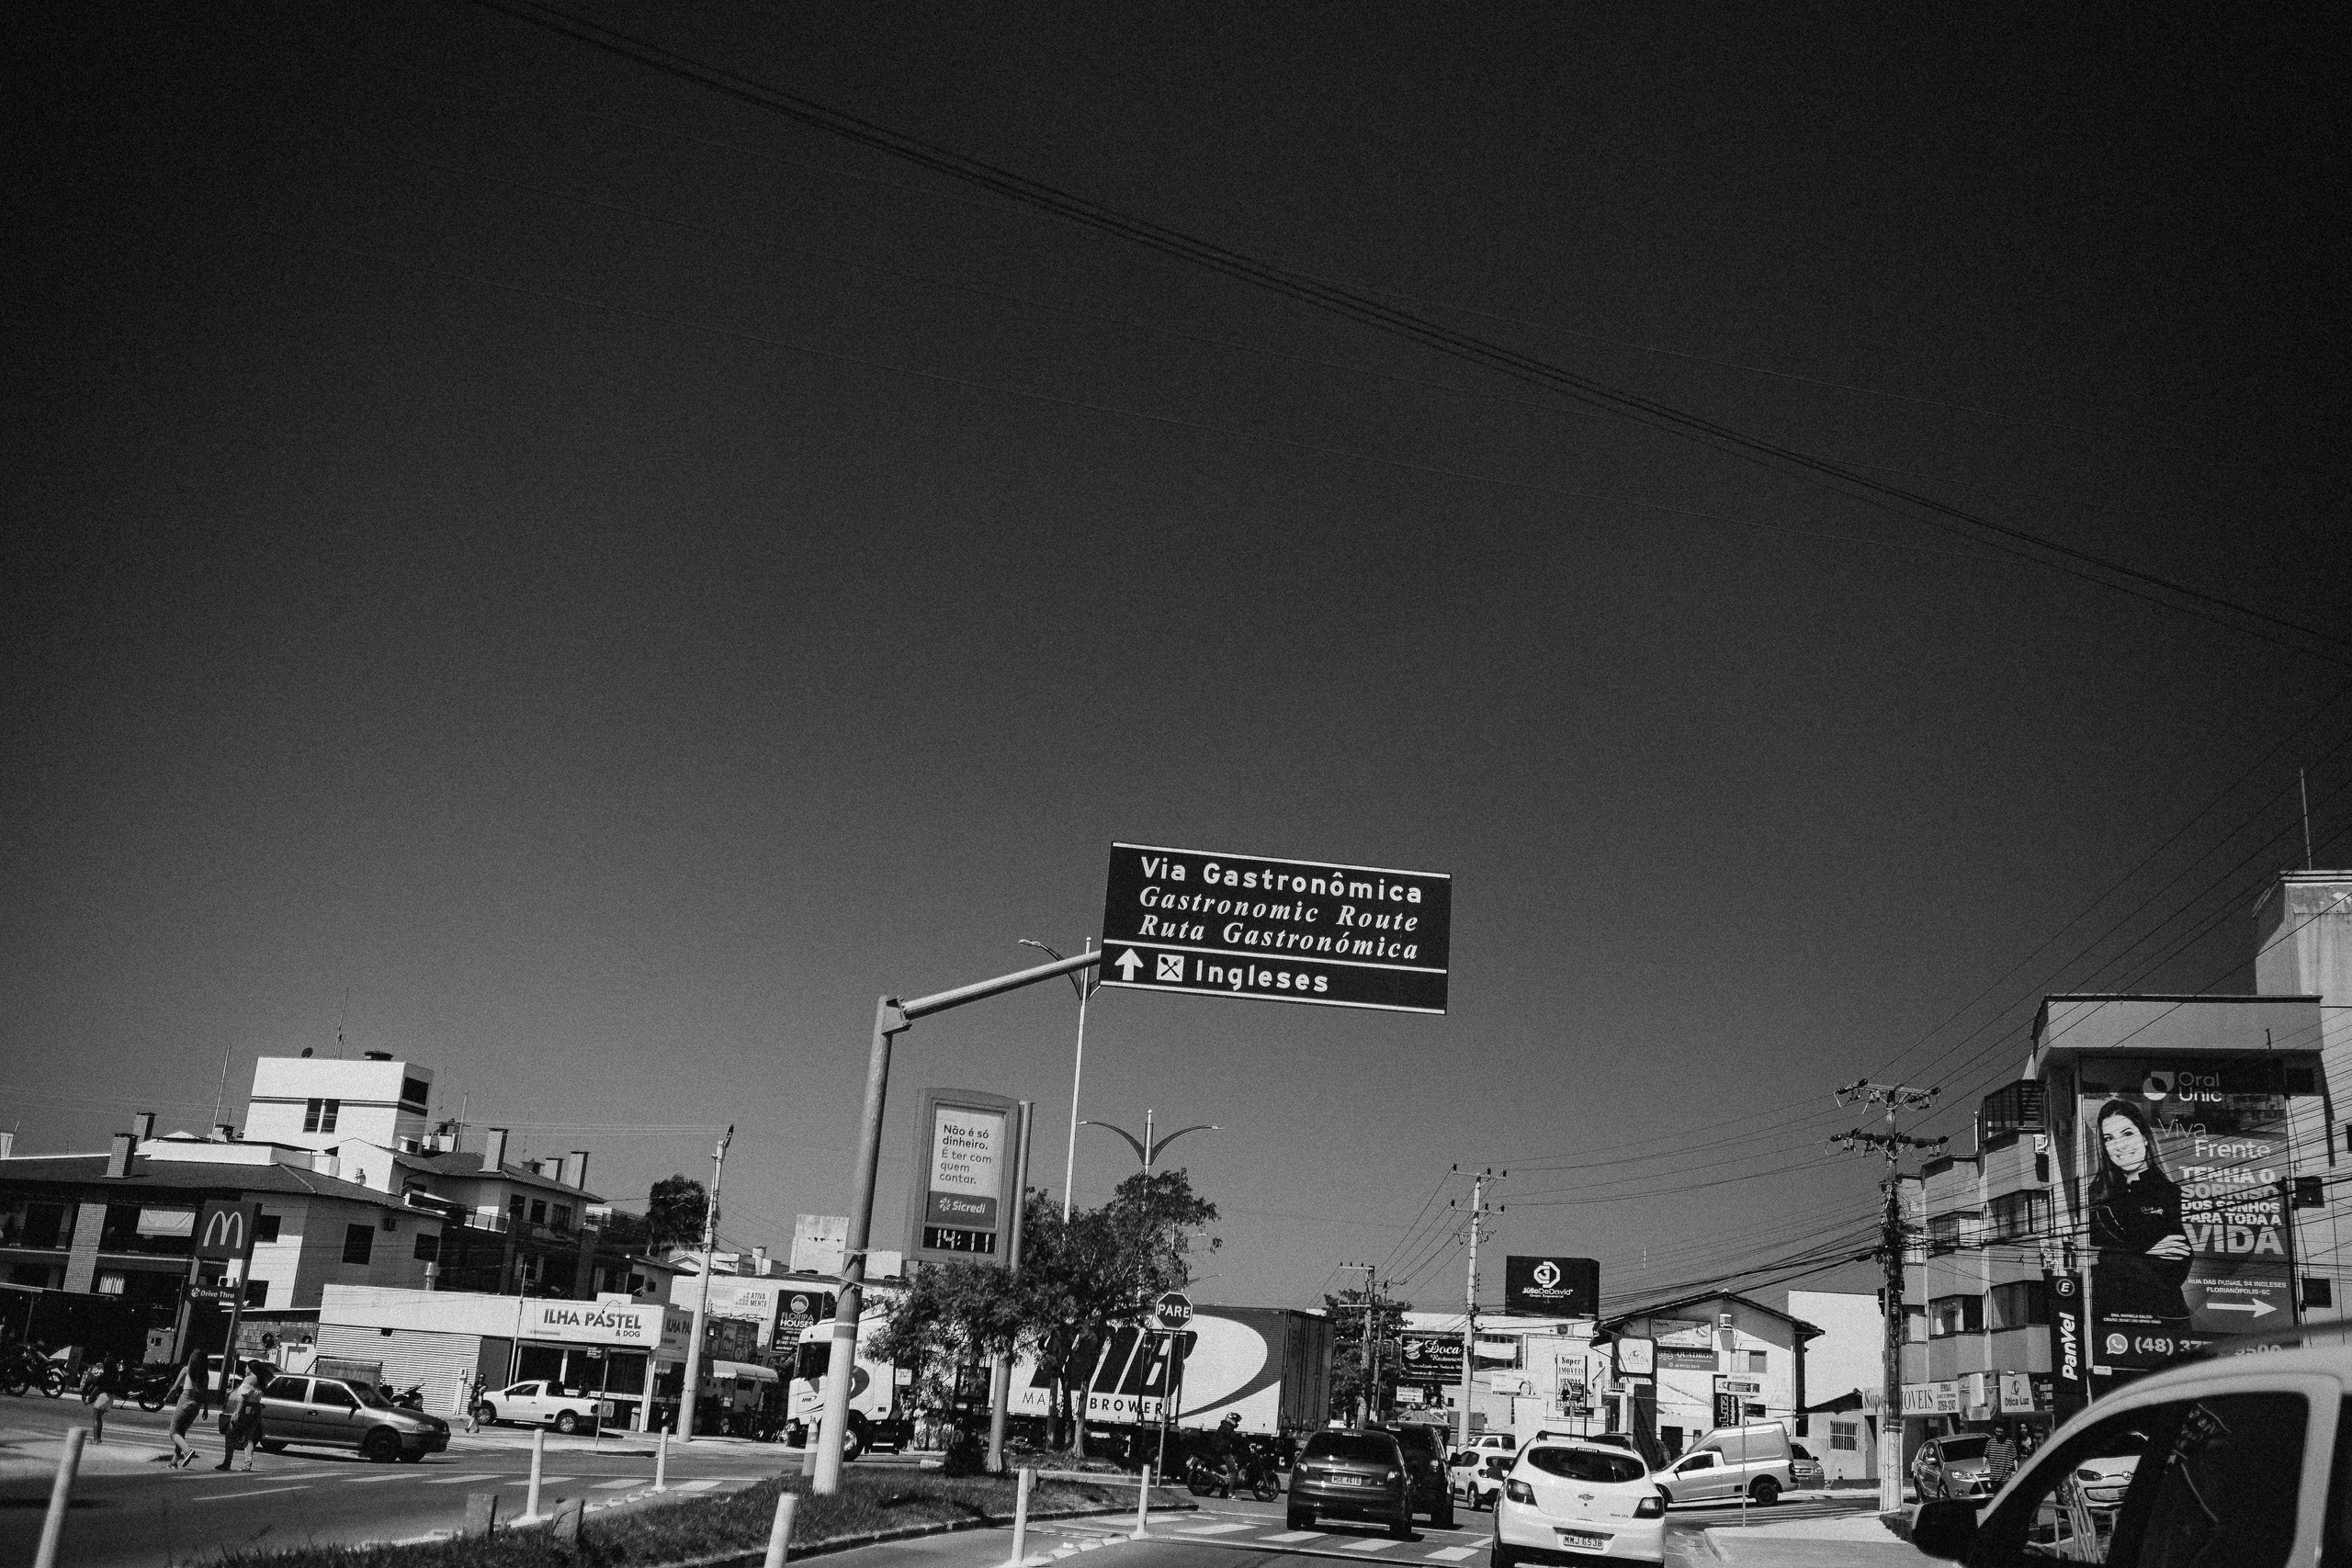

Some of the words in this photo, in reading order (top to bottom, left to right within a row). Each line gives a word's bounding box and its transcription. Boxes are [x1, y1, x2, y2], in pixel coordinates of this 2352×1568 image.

[1140, 856, 1186, 882] Via
[1203, 863, 1421, 903] Gastronômica
[1139, 886, 1319, 923] Gastronomic
[1336, 904, 1419, 932] Route
[1137, 914, 1204, 941] Ruta
[1223, 922, 1419, 960] Gastronómica
[1196, 959, 1329, 992] Ingleses
[2179, 1072, 2220, 1087] Oral
[2179, 1087, 2222, 1102] Unic
[944, 1124, 966, 1136] Não
[968, 1128, 974, 1137] é
[978, 1130, 989, 1139] só
[2158, 1118, 2207, 1139] Viva
[943, 1136, 989, 1150] dinheiro.
[2195, 1139, 2270, 1158] Frente
[942, 1147, 948, 1158] É
[952, 1151, 967, 1161] ter
[970, 1155, 992, 1164] com
[941, 1162, 970, 1173] quem
[2179, 1167, 2256, 1183] TENHA
[2260, 1168, 2276, 1183] O
[940, 1173, 977, 1185] contar.
[952, 1201, 986, 1213] Sicredi
[2181, 1212, 2222, 1224] PARA
[2225, 1213, 2268, 1224] TODA
[2270, 1214, 2283, 1225] A
[2182, 1224, 2285, 1255] VIDA
[200, 1290, 218, 1298] Drive
[2061, 1282, 2070, 1292] E
[781, 1313, 814, 1321] FLORIPA
[1158, 1304, 1191, 1318] PARE
[544, 1309, 580, 1325] ILHA
[585, 1313, 642, 1330] PASTEL
[780, 1319, 814, 1327] HOUSES
[2135, 1337, 2174, 1356] (48)
[1562, 1357, 1581, 1366] Super
[1677, 1351, 1713, 1360] QUADROS
[1090, 1398, 1163, 1415] BROWER
